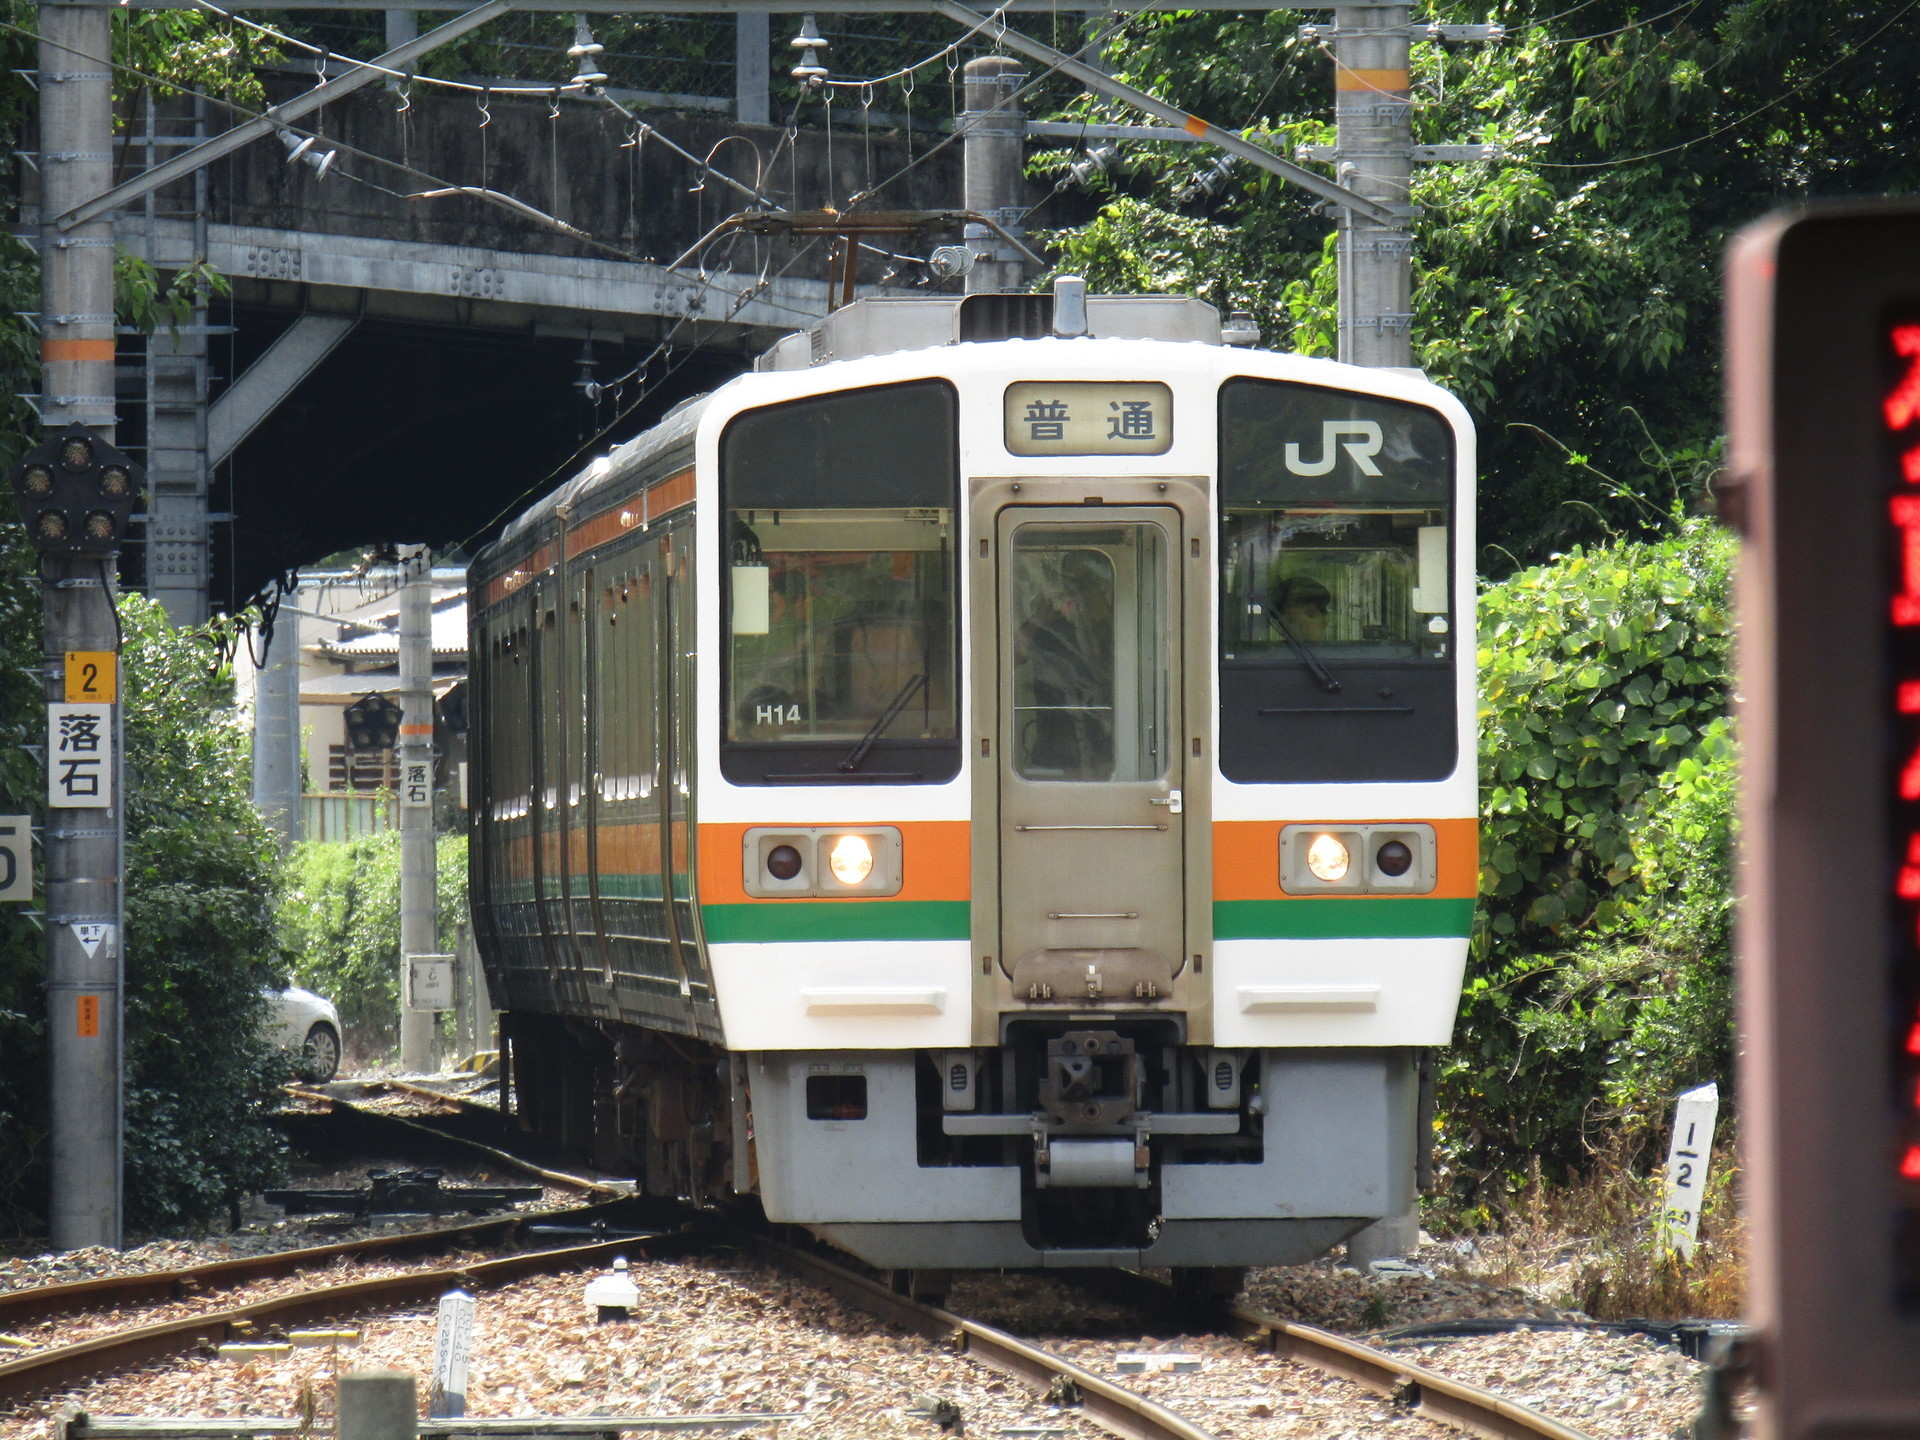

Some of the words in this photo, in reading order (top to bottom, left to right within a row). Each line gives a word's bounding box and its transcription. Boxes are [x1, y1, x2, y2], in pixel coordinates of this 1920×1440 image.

[1023, 399, 1156, 441] 普通
[1285, 420, 1383, 477] JR
[82, 663, 97, 692] 2
[756, 704, 801, 726] H14
[59, 713, 101, 797] 落石
[408, 765, 427, 802] 落石
